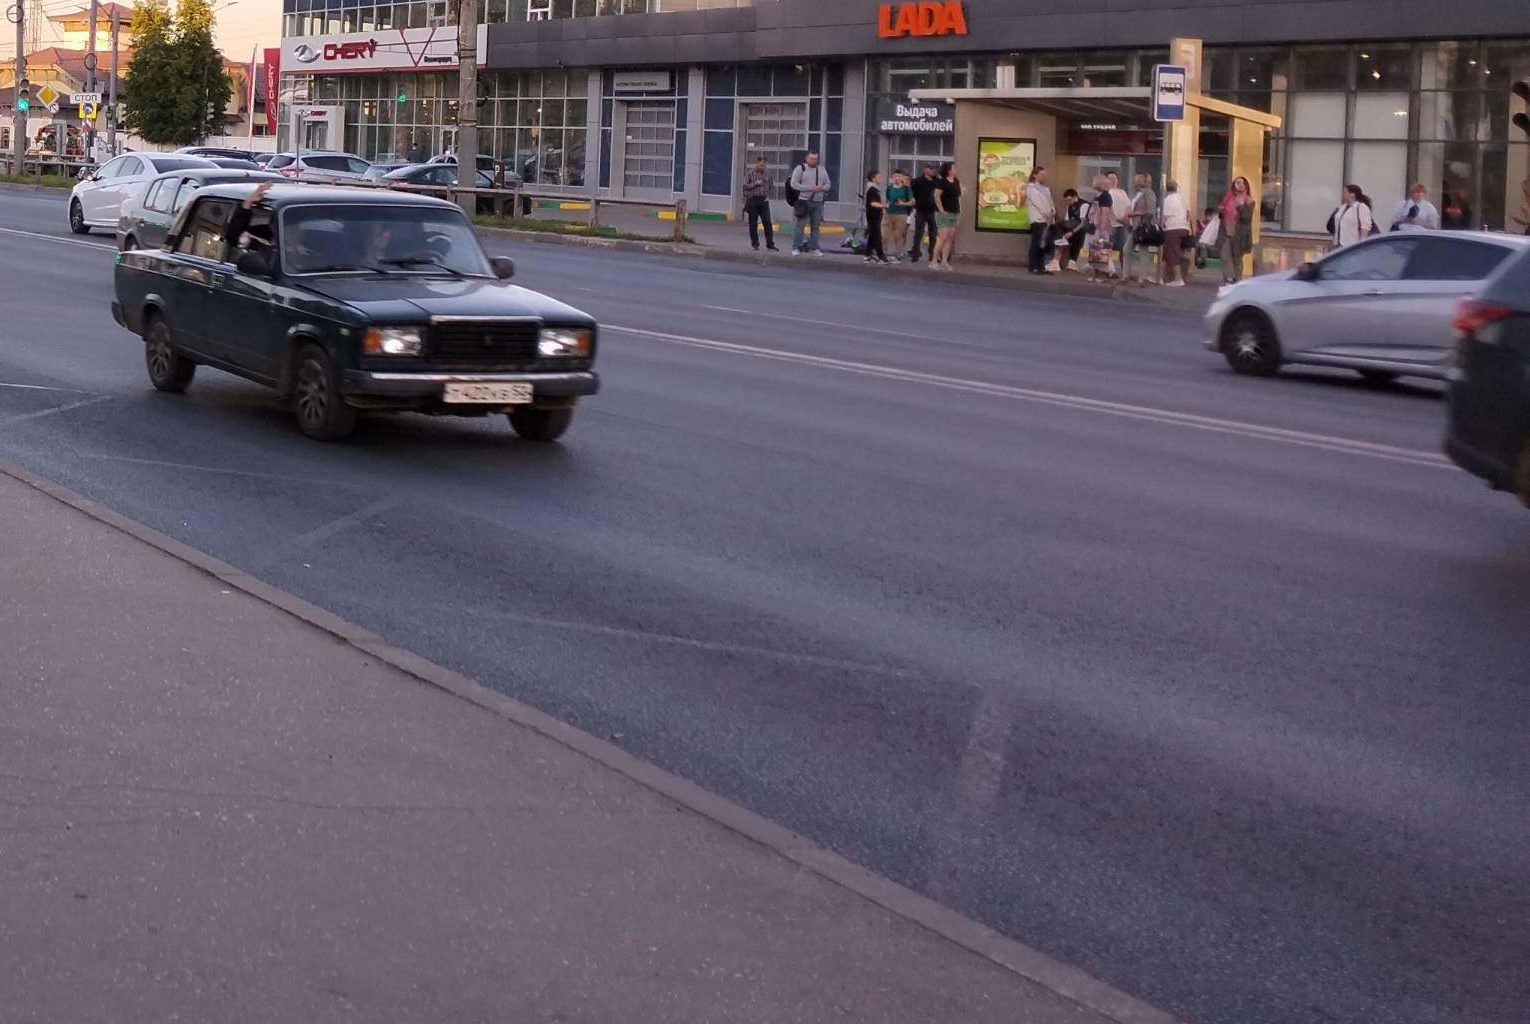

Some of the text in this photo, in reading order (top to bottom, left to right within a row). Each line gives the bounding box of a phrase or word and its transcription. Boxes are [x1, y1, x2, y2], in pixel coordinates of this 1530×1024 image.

[878, 0, 967, 38] LADA
[323, 41, 376, 60] CHERY
[896, 104, 938, 119] Выдача
[881, 118, 953, 132] автомобилей
